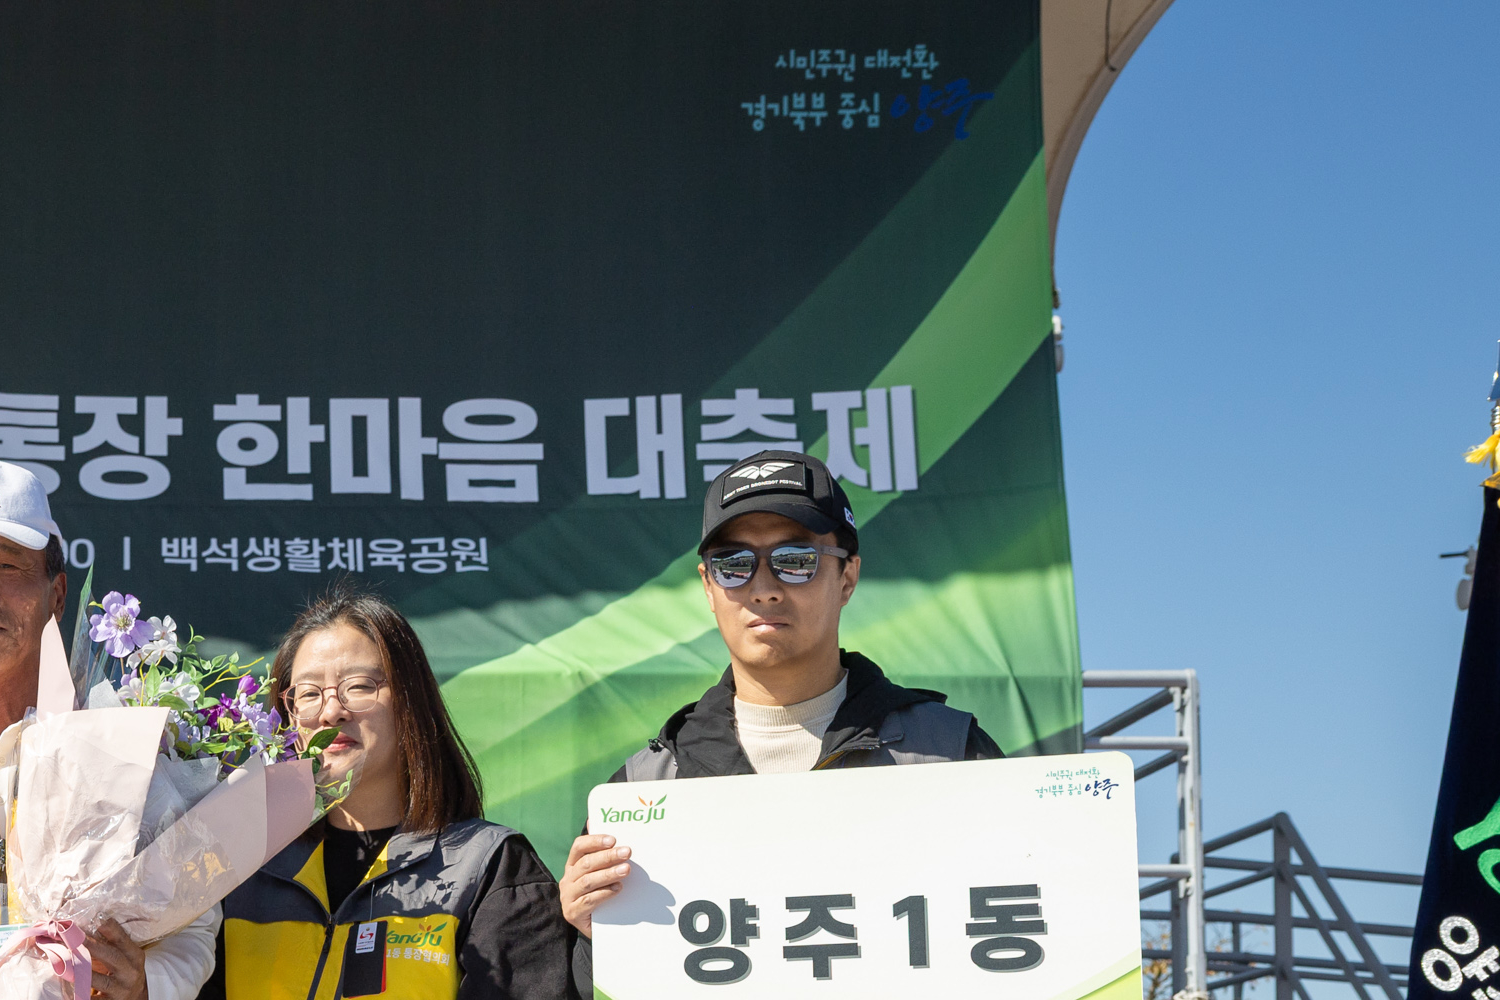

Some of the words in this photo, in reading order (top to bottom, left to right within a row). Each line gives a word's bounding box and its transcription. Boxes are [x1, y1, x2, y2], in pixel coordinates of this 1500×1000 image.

[775, 49, 856, 82] 시민주권
[864, 44, 940, 80] 대전환
[741, 92, 828, 132] 경기북부
[838, 92, 880, 129] 중심
[890, 78, 995, 141] 양주
[212, 391, 544, 502] 한마음
[583, 384, 920, 500] 대축제
[160, 534, 491, 575] 백석생활체육공원
[1035, 784, 1064, 799] 경기북부
[1067, 783, 1082, 795] 중심
[1085, 778, 1119, 800] 양주
[1046, 769, 1073, 781] 시민주권
[1075, 766, 1100, 779] 대전환
[404, 947, 450, 967] 통장협의회
